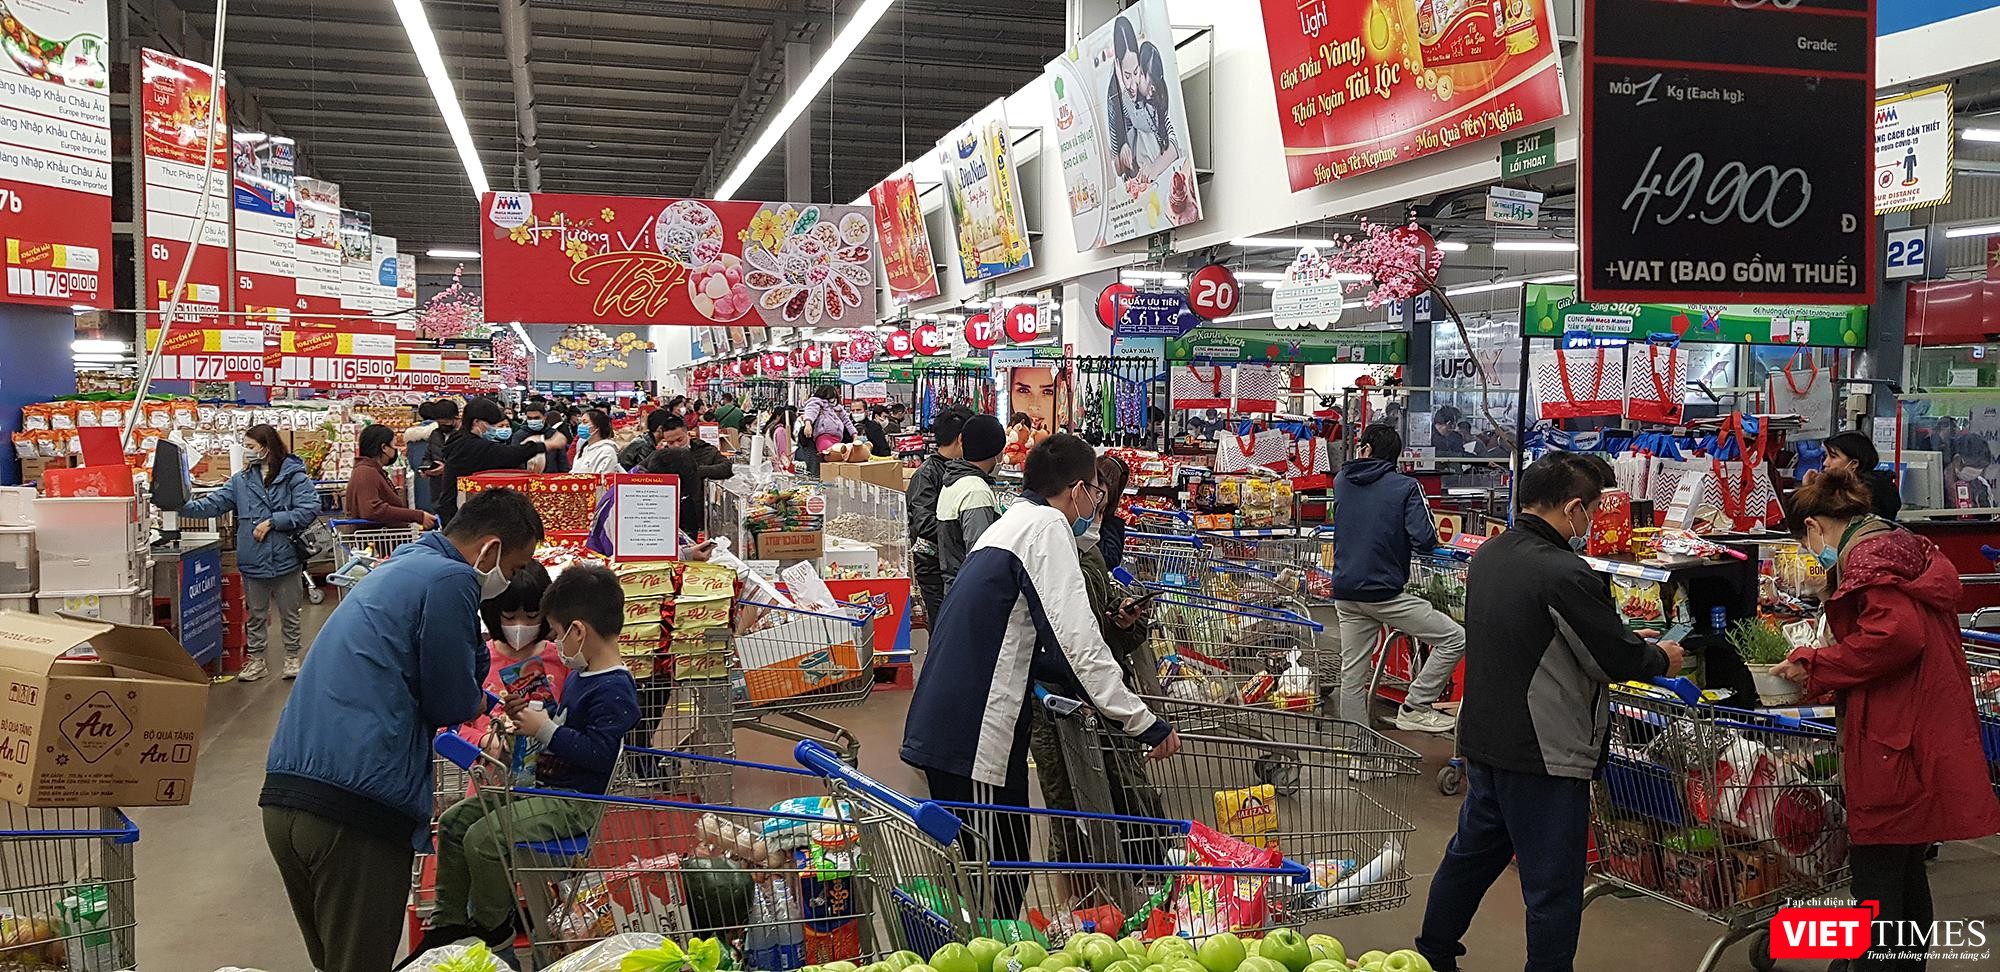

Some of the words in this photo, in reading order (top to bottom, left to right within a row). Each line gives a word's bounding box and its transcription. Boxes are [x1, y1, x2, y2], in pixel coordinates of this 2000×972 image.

[1300, 1, 1328, 38] Light
[1797, 37, 1838, 52] Grade:
[1280, 70, 1298, 90] Giọt
[1300, 57, 1321, 81] Dầu
[1320, 36, 1366, 69] Vàng,
[1346, 67, 1370, 101] Tài
[1374, 61, 1400, 98] Lộc
[1668, 86, 1684, 100] Kg
[1688, 87, 1720, 100] (Each
[1724, 89, 1744, 104] kg):
[58, 106, 79, 117] Europe
[80, 110, 105, 122] Imported
[60, 141, 80, 152] Europe
[82, 144, 106, 156] Imported
[1332, 160, 1347, 178] Quà
[1348, 152, 1361, 170] Tết
[1361, 146, 1398, 169] Neptune
[1416, 134, 1438, 152] Món
[1440, 126, 1460, 147] Quà
[1460, 113, 1480, 138] Tết
[1488, 103, 1523, 134] Nghĩa
[1517, 136, 1540, 155] EXIT
[62, 176, 82, 186] Europe
[82, 180, 107, 190] Imported
[1622, 147, 1811, 234] 49.900
[1888, 188, 1920, 199] DISTANCE
[528, 212, 610, 254] Hương
[617, 216, 654, 252] Vị
[152, 244, 169, 260] 6b
[1888, 238, 1924, 268] 22
[1605, 260, 1664, 282] +VAT
[1670, 261, 1726, 283] (BAO
[1733, 253, 1786, 283] GỒM
[1792, 256, 1856, 286] THUẾ)
[240, 276, 252, 289] 5b
[570, 250, 686, 317] Tết
[1197, 279, 1232, 310] 20
[297, 299, 308, 309] 4b
[1388, 302, 1403, 316] 19
[1416, 296, 1430, 313] 20
[974, 322, 990, 340] 17
[1016, 313, 1036, 334] 18
[892, 336, 908, 350] 15
[921, 331, 938, 347] 16
[1441, 358, 1476, 379] UFO
[75, 710, 116, 739] An
[140, 744, 168, 764] An
[163, 782, 174, 800] 4
